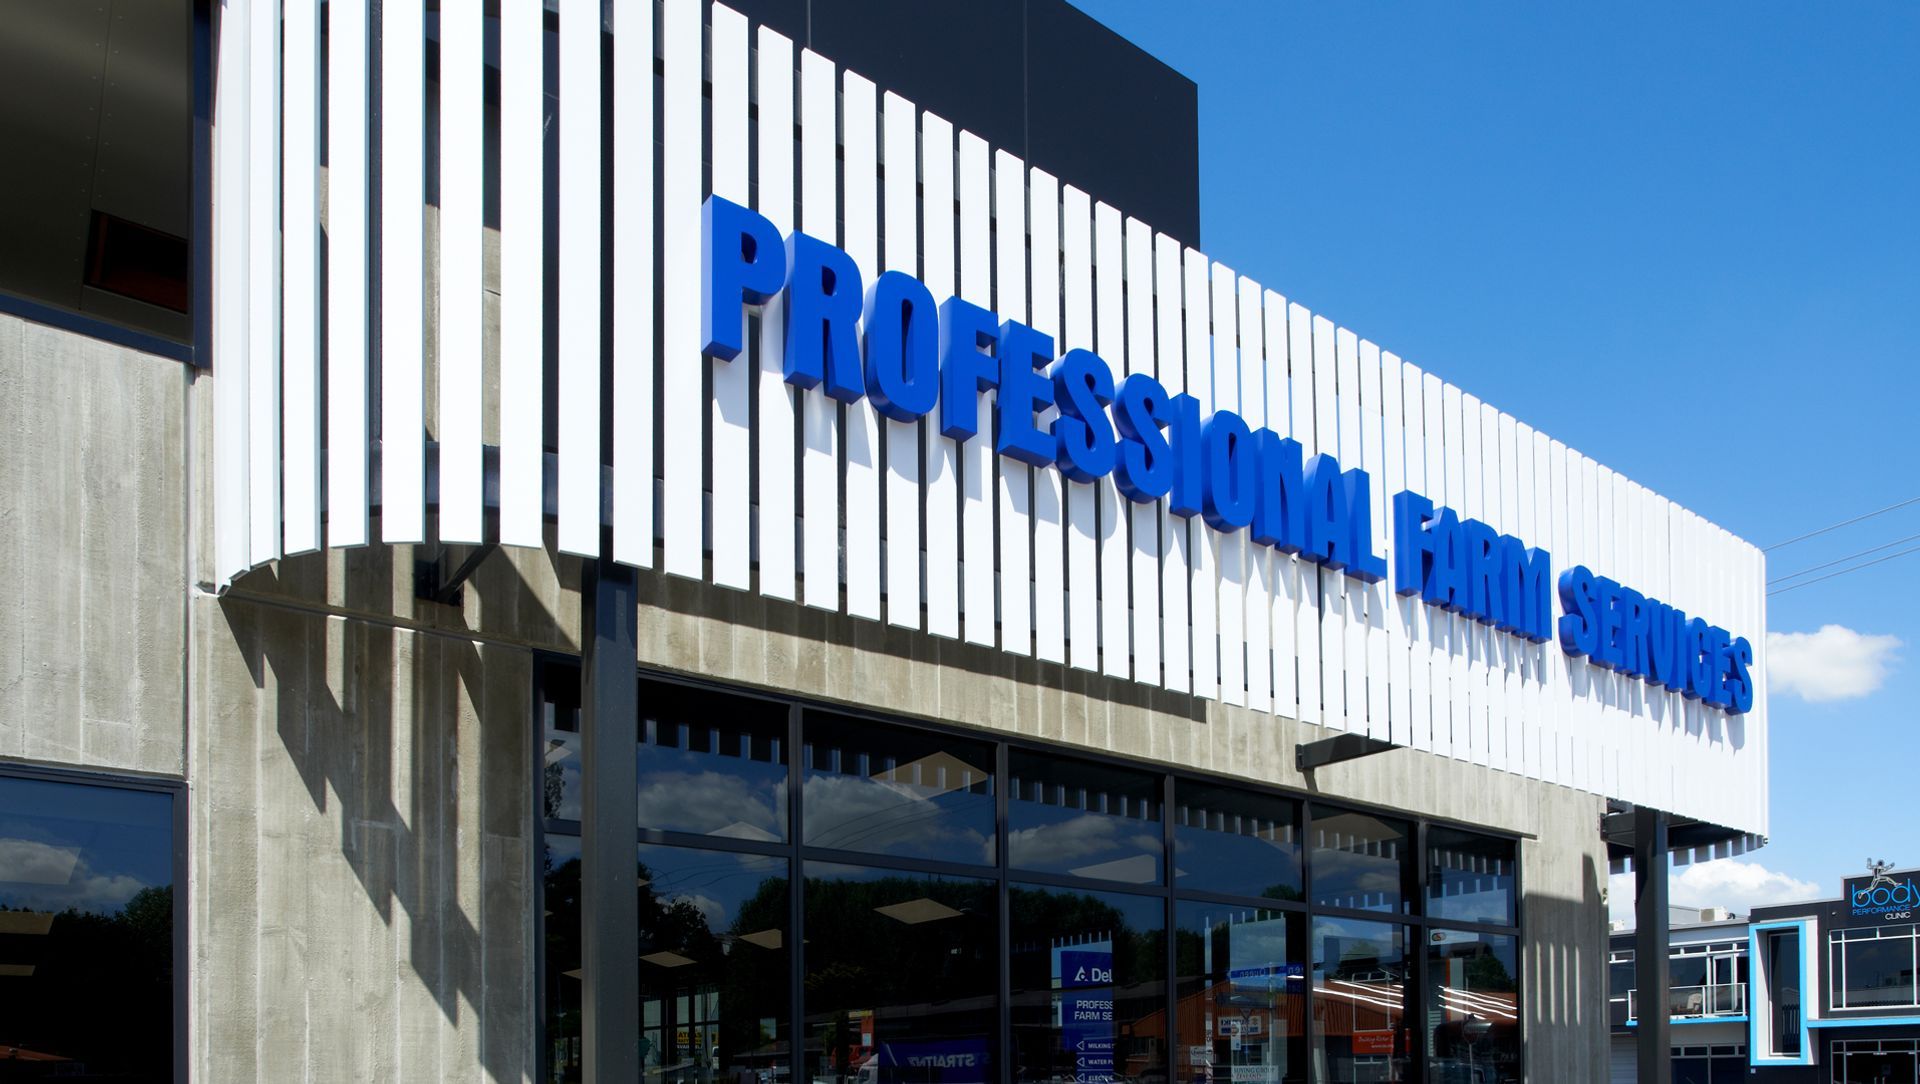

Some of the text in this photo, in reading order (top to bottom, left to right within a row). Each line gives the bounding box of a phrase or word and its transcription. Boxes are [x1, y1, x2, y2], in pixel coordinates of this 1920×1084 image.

[701, 194, 1753, 715] PROFESSIONAL FARM SERVICES
[1851, 877, 1920, 908] body
[1852, 904, 1911, 916] PERFORMANCE
[1884, 911, 1911, 920] CLINIC
[1074, 1011, 1101, 1021] FARM
